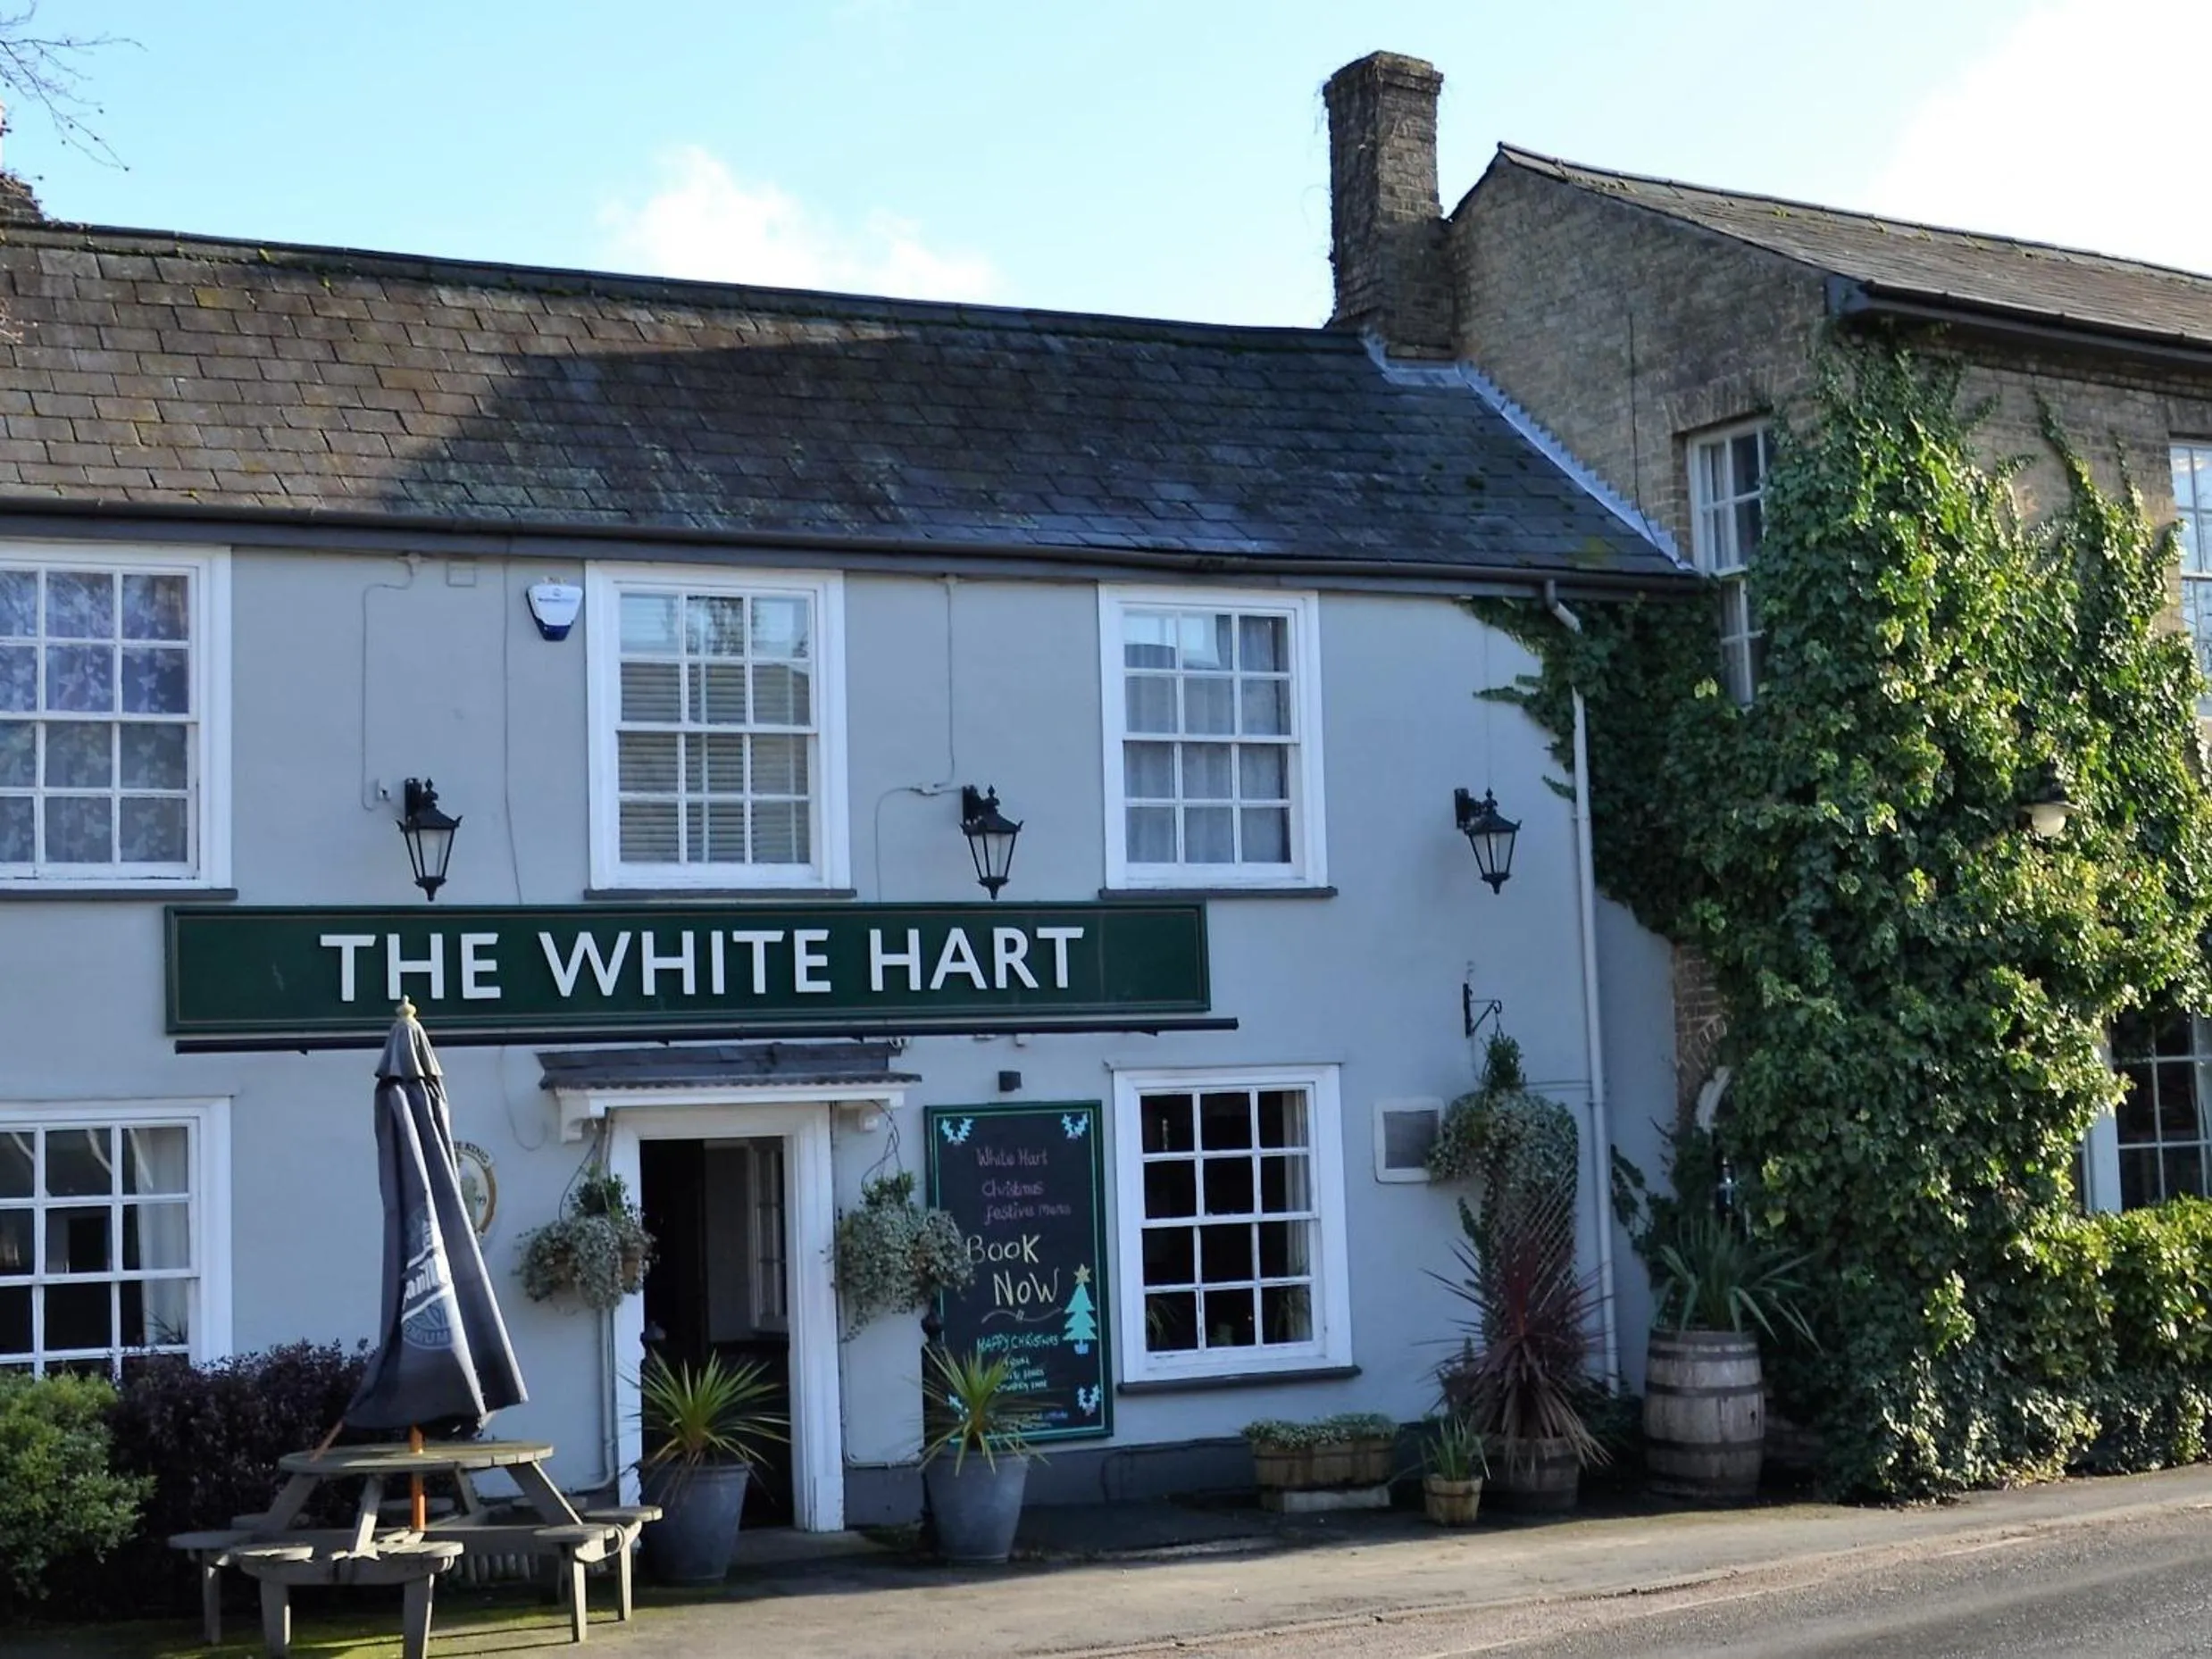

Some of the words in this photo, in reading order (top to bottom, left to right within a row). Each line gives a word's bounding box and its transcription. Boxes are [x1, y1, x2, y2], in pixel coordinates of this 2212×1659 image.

[320, 932, 501, 1002] THE
[538, 930, 831, 997] WHITE
[869, 927, 1084, 991] HART
[976, 1146, 1015, 1166] White
[1017, 1146, 1048, 1166] Hart
